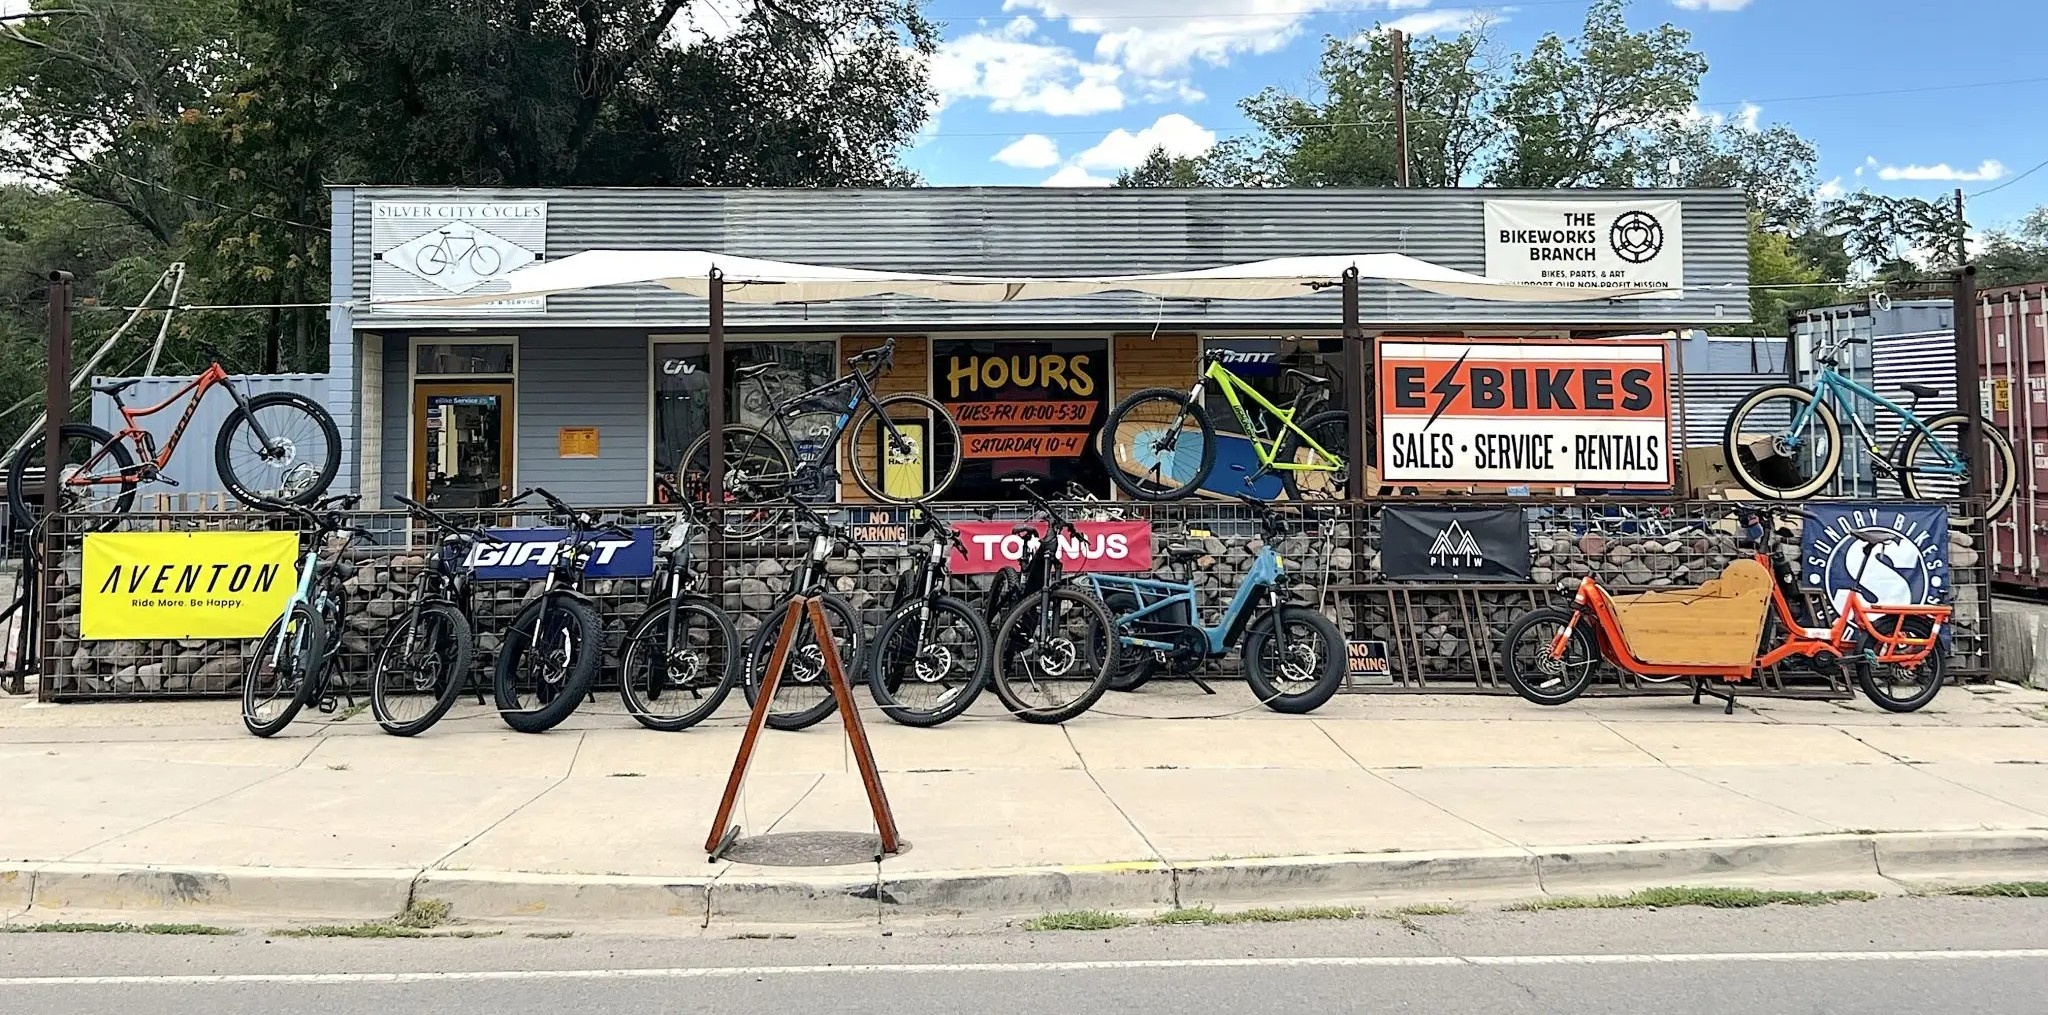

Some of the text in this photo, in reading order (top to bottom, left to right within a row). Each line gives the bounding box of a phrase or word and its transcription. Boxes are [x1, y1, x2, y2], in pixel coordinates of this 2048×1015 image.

[378, 206, 541, 217] SILVER CITY CYCLES
[1564, 213, 1596, 226] THE
[1500, 230, 1596, 243] BIKEWORKS
[1530, 248, 1596, 261] BRANCH
[1541, 270, 1568, 278] BIKES,
[1570, 270, 1598, 278] PARTS,
[663, 360, 697, 375] Liv
[947, 354, 1094, 398] HOURS
[956, 403, 1087, 421] TUES-FRI 10:00-5:30
[971, 437, 1078, 455] SATURDAY 10-4
[1393, 432, 1659, 471] SALES SERVICE RENTALS
[869, 511, 890, 524] NO
[853, 526, 906, 541] PARKING
[1808, 508, 1943, 570] SUNDAY BIKES
[100, 563, 280, 594] AVENTON
[132, 599, 244, 609] Ride More. Be Happy.
[1349, 643, 1369, 657] NO
[1349, 657, 1387, 671] RKING
